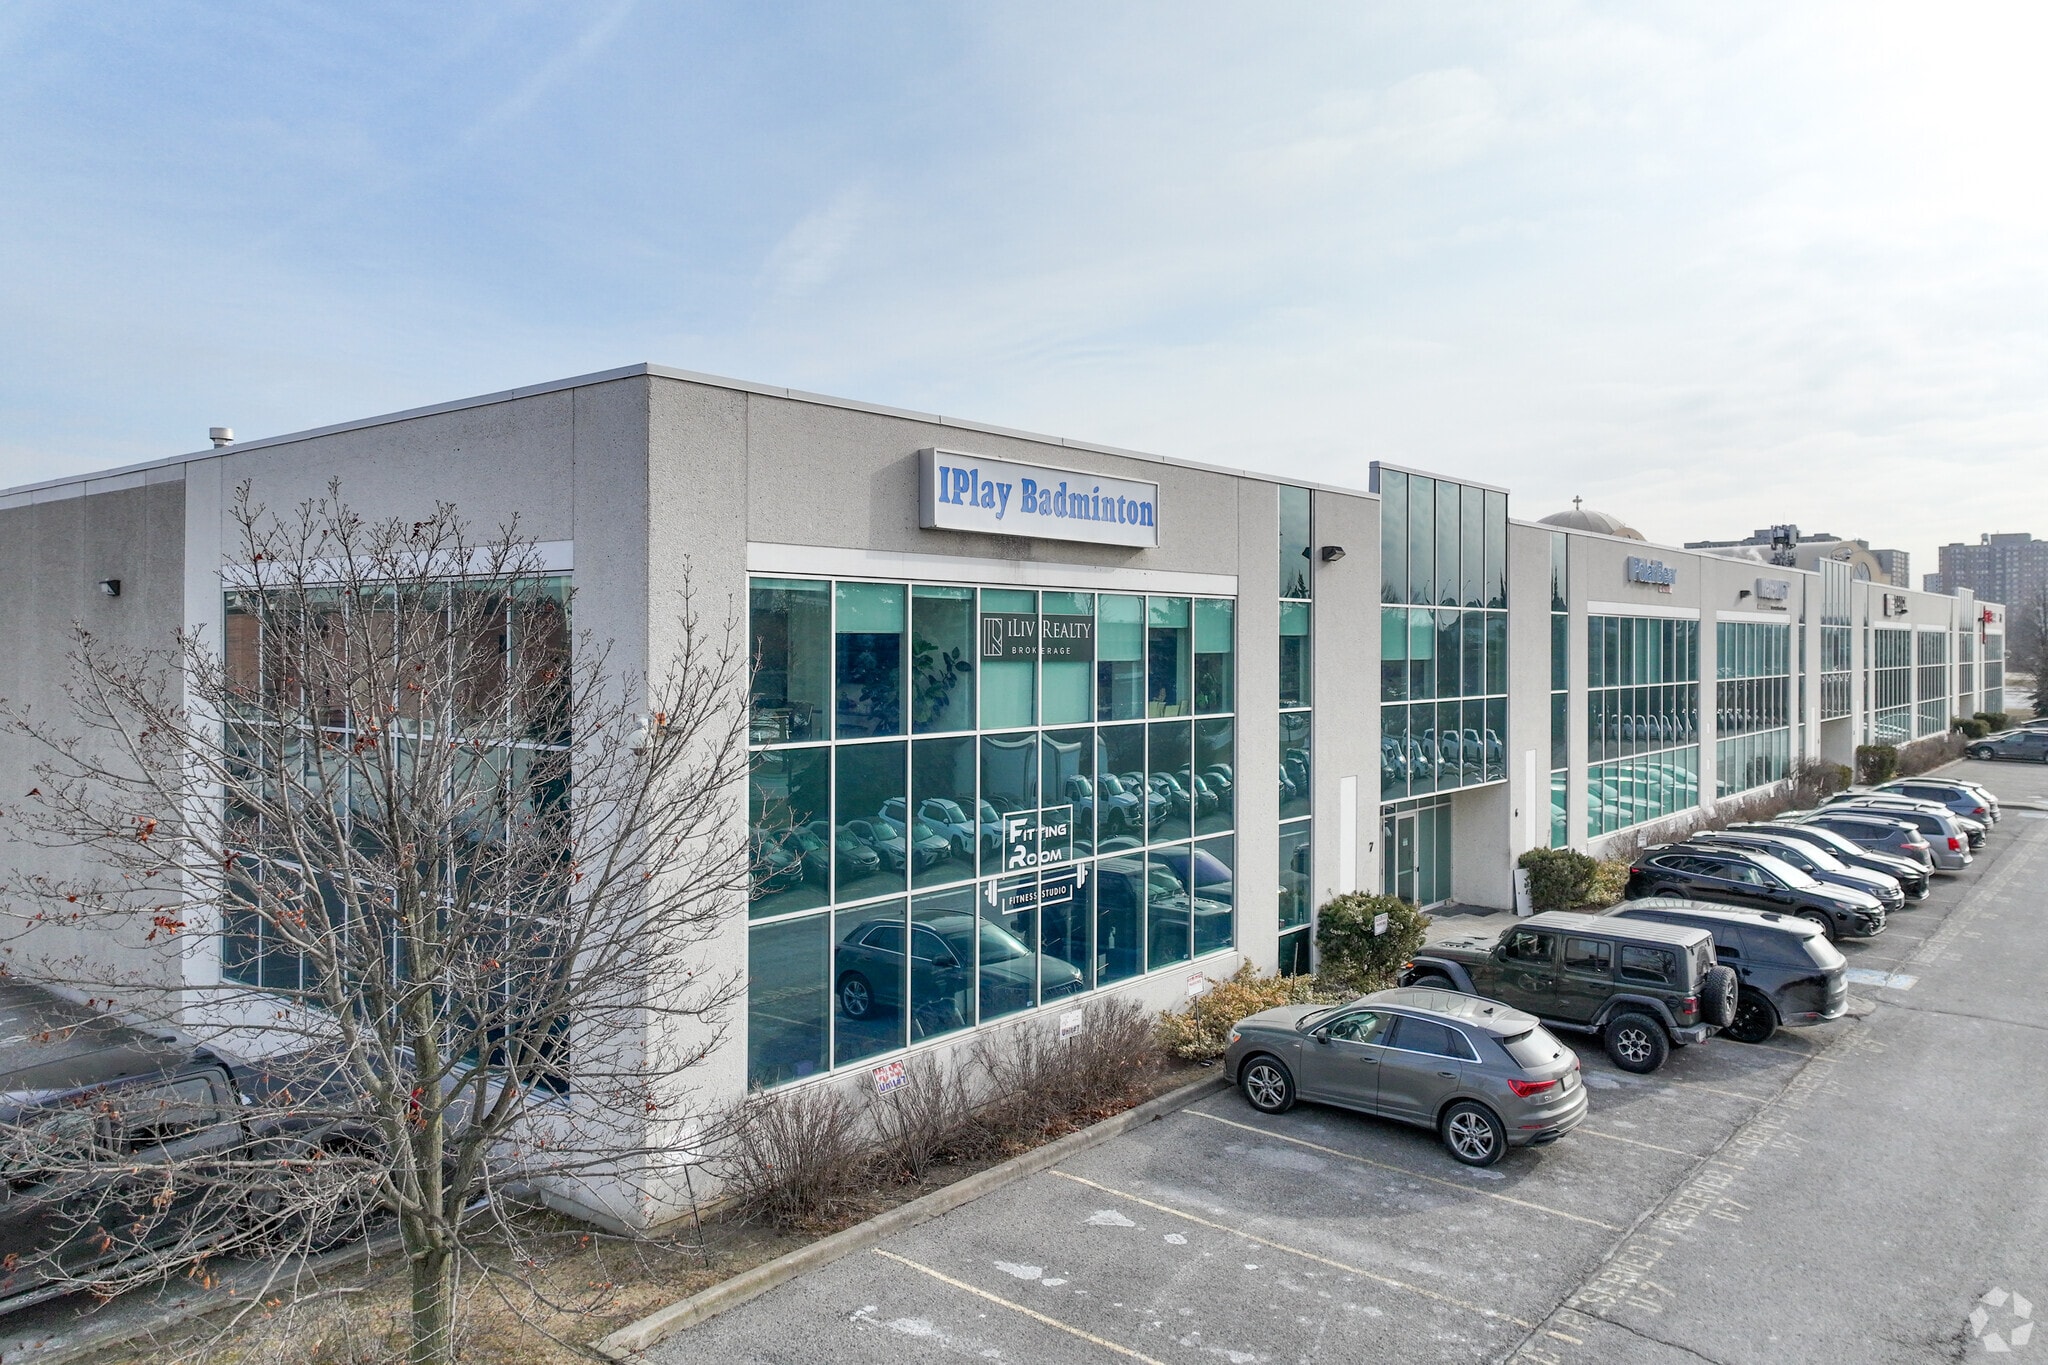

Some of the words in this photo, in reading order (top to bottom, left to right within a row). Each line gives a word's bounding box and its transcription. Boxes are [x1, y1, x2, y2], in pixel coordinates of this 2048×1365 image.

[938, 466, 1012, 520] IPlay
[1021, 478, 1154, 527] Badminton
[1011, 646, 1071, 655] BROKERAGE
[1008, 844, 1062, 869] ROOM
[1369, 841, 1374, 853] 7
[1009, 891, 1037, 905] FITNESS
[1041, 885, 1067, 898] STUDIO
